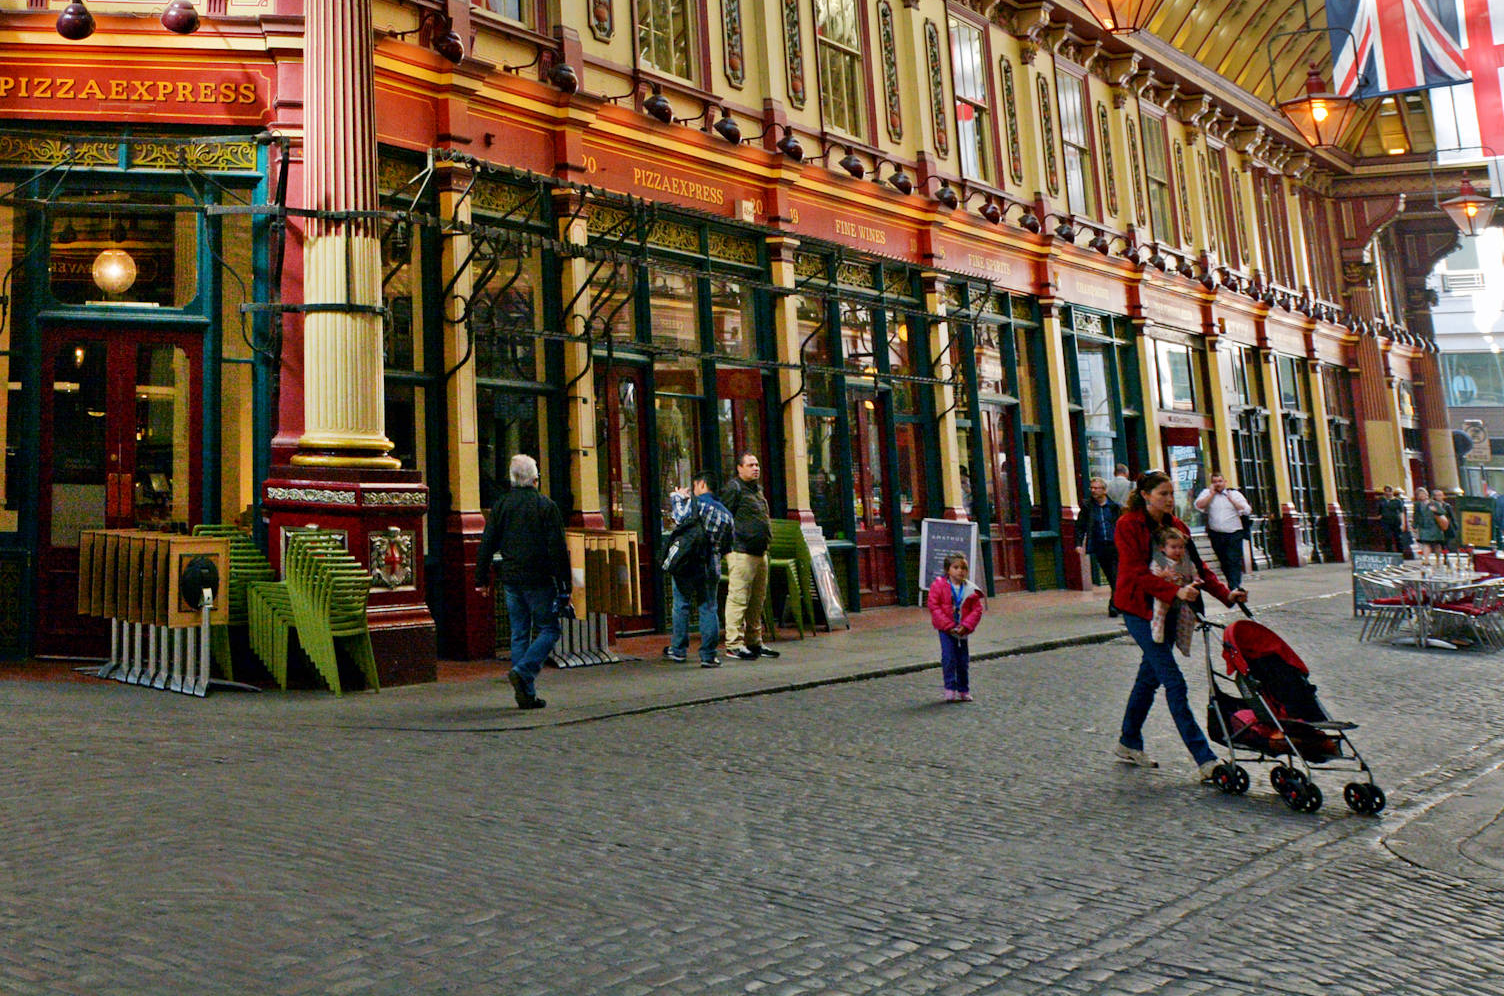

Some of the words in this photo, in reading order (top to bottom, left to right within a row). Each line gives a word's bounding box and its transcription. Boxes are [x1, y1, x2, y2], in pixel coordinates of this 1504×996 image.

[633, 166, 725, 206] PIZZAEXPRESS
[835, 219, 857, 238] FINE
[858, 223, 887, 246] WINES
